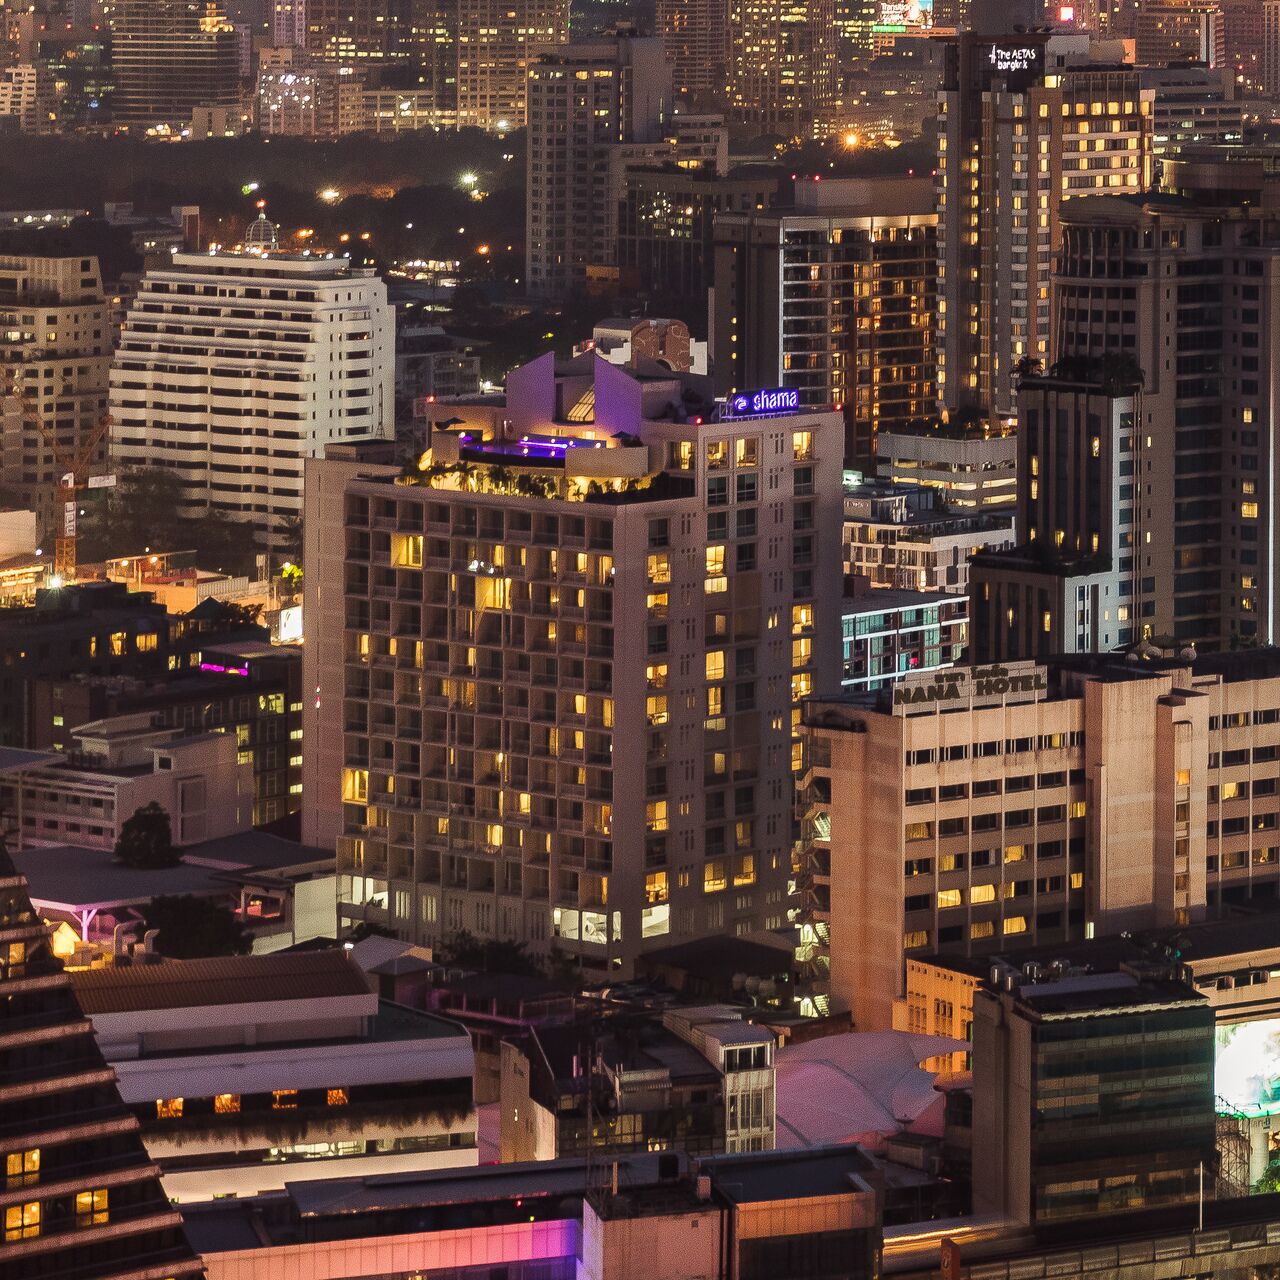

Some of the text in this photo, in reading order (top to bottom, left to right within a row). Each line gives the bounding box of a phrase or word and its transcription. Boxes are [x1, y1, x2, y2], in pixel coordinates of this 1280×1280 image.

[753, 390, 797, 410] shama
[894, 674, 1047, 705] NANA HOTEL
